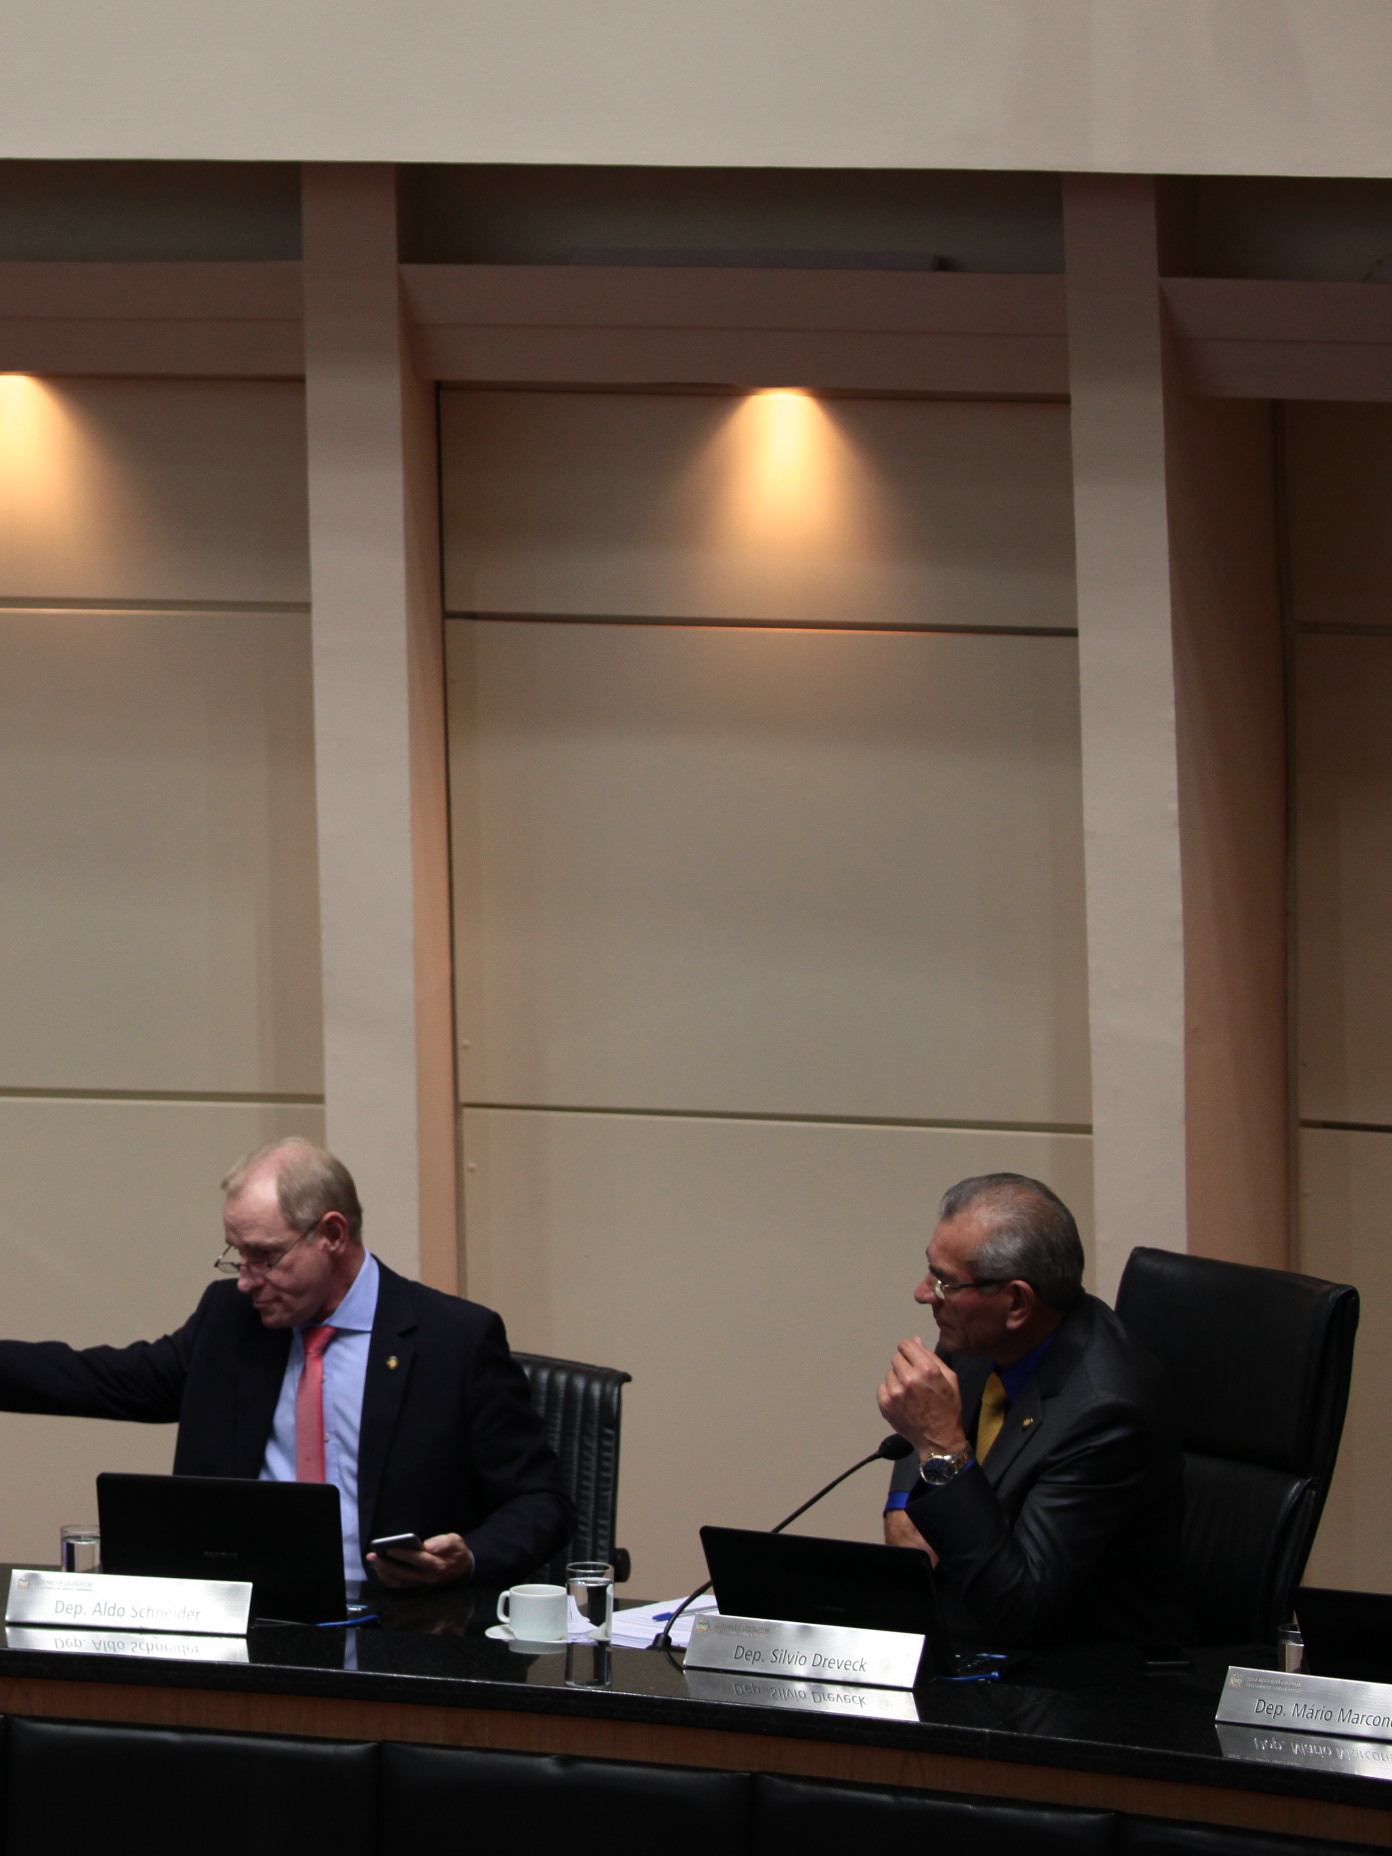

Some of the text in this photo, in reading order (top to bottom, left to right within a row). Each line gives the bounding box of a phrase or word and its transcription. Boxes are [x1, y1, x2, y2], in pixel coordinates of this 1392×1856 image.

[54, 1600, 201, 1621] Dep. Aldo Schneider
[733, 1645, 868, 1673] Dep. Silvio Dreveck
[1255, 1698, 1392, 1729] Dep. Mário Marcon
